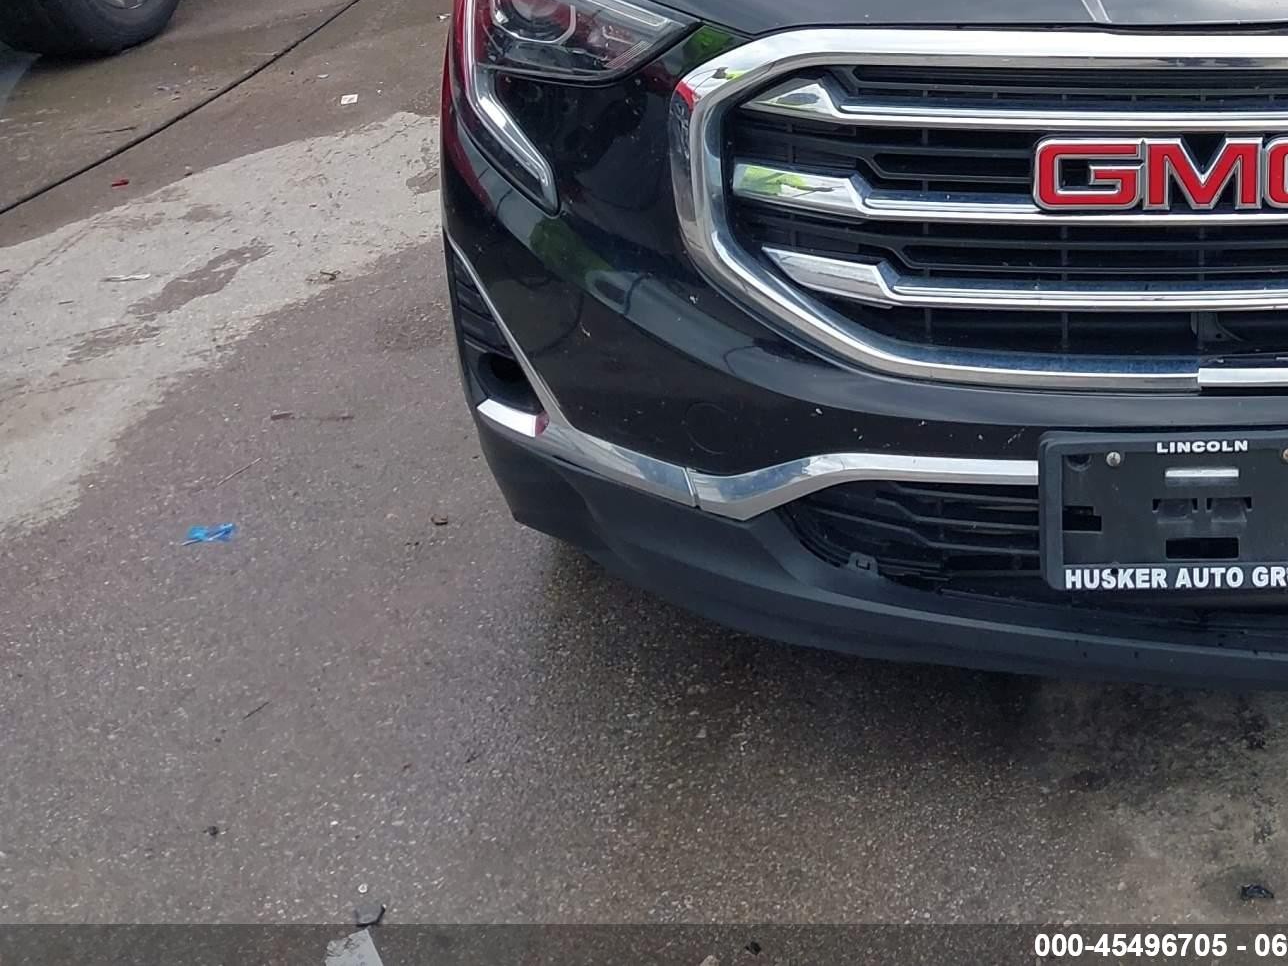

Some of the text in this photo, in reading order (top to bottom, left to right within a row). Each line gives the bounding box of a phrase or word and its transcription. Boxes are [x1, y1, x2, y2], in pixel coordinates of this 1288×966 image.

[1156, 440, 1249, 454] LINCOLN
[1064, 567, 1168, 590] HUSKER
[1174, 566, 1244, 588] AUTO
